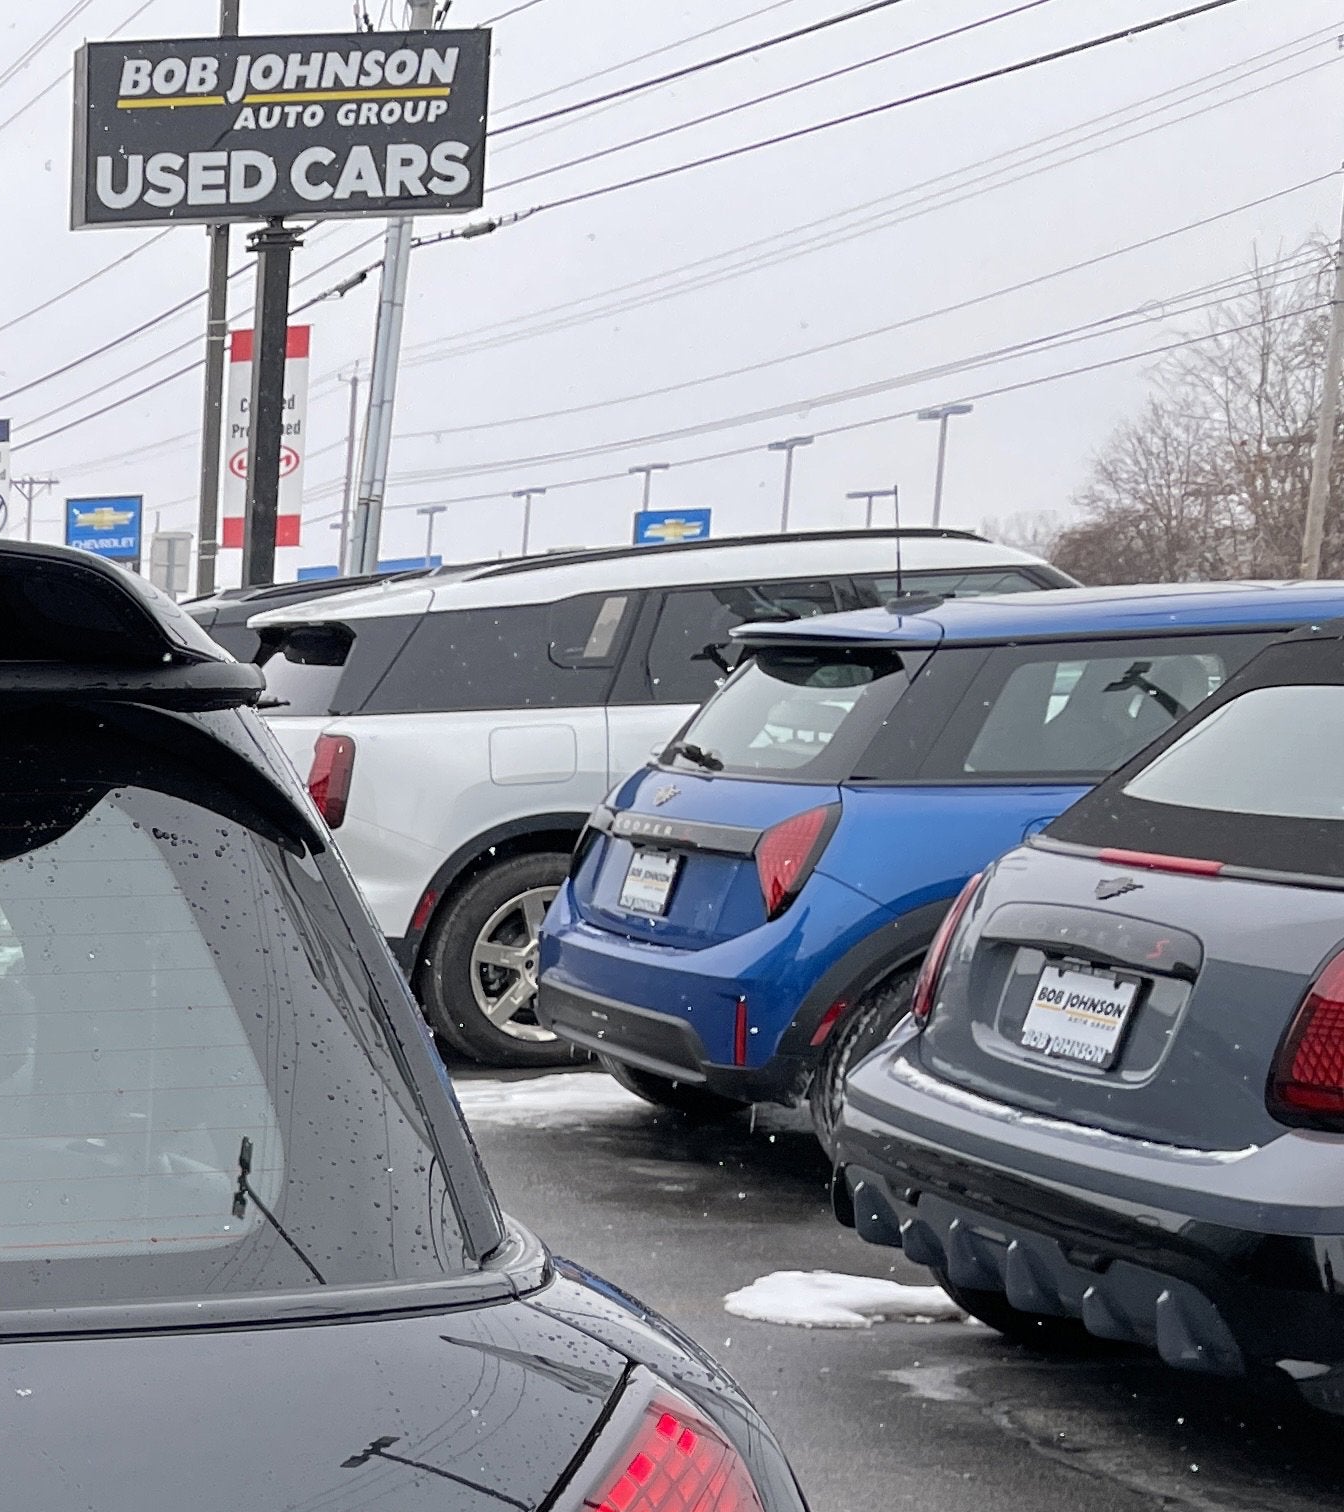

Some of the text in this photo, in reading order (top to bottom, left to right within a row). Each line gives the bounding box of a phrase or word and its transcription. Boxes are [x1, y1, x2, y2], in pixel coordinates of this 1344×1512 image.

[118, 47, 459, 104] BOB JOHNSON
[233, 100, 449, 131] AUTO GROUP
[96, 141, 471, 210] USED CARS
[1037, 987, 1127, 1019] BOB JOHNSON
[1044, 1036, 1107, 1063] JOHNSON
